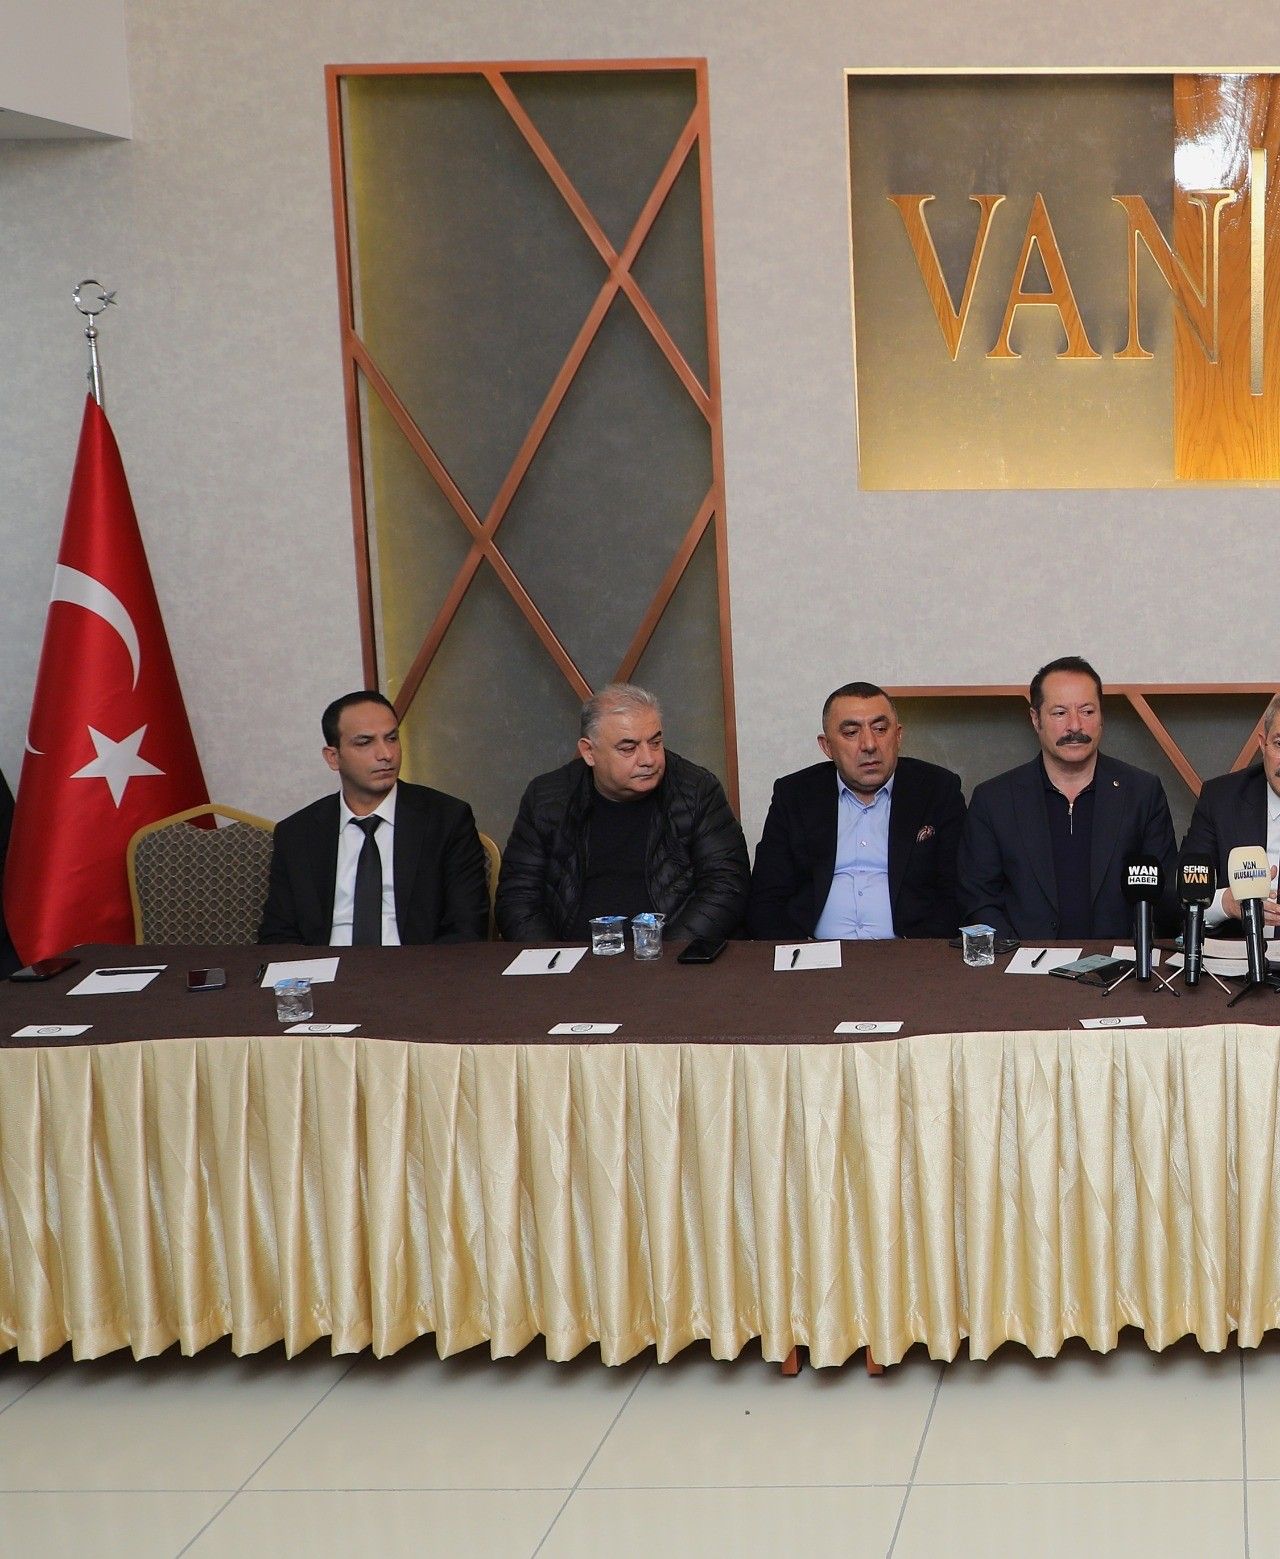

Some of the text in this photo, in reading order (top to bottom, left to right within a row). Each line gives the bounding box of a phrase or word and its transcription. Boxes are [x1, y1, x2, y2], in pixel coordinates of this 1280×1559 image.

[887, 189, 1236, 365] VAN
[1128, 865, 1158, 876] WAN
[1242, 861, 1257, 870] VAN
[1129, 876, 1157, 884] HABER
[1183, 873, 1208, 884] VAN
